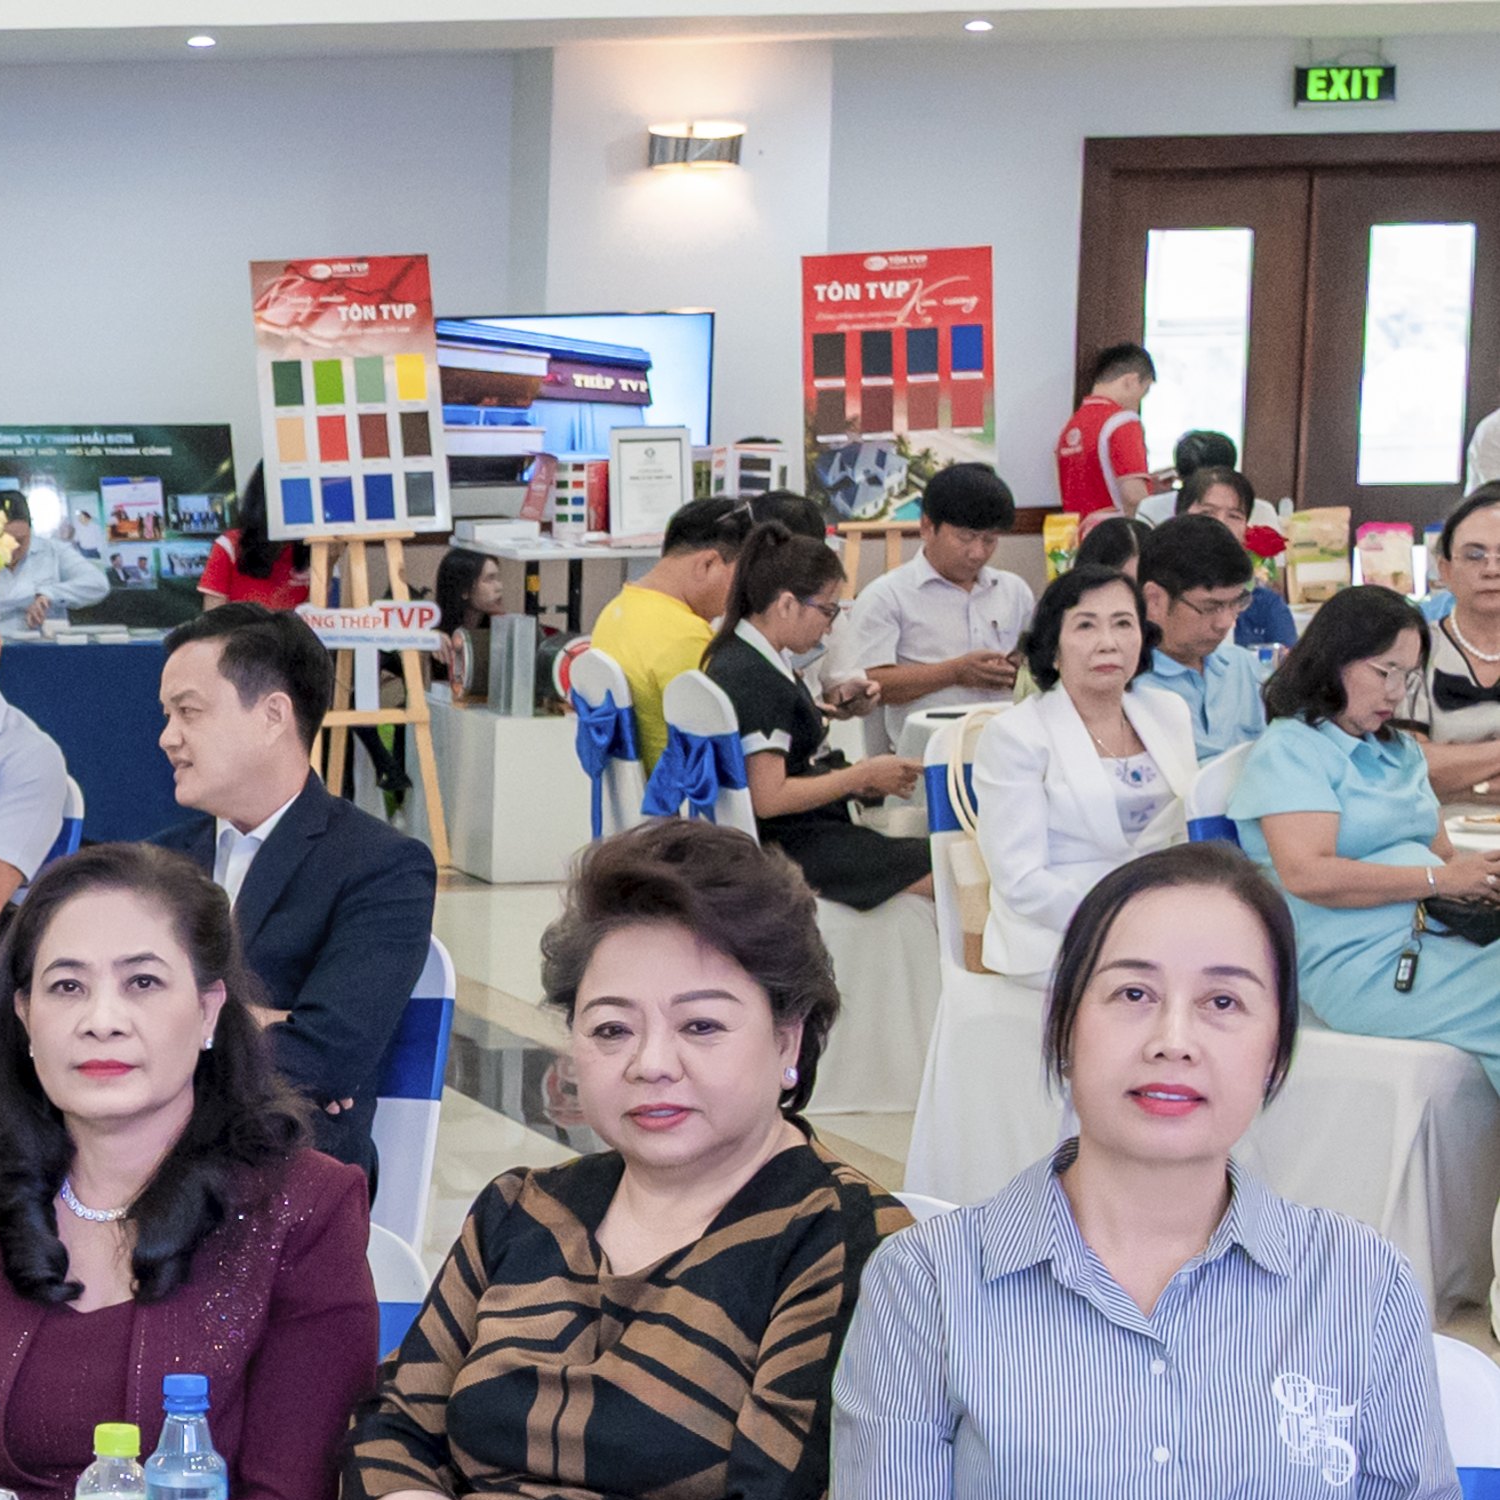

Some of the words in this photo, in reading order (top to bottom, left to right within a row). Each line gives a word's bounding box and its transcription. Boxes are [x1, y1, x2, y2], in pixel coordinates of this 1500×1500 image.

[1307, 68, 1384, 101] EXIT
[814, 281, 861, 302] TÔN
[865, 280, 911, 300] TVP
[337, 302, 376, 321] TÔN
[379, 302, 417, 320] TVP
[340, 612, 381, 629] THÉP
[380, 606, 434, 629] TVP
